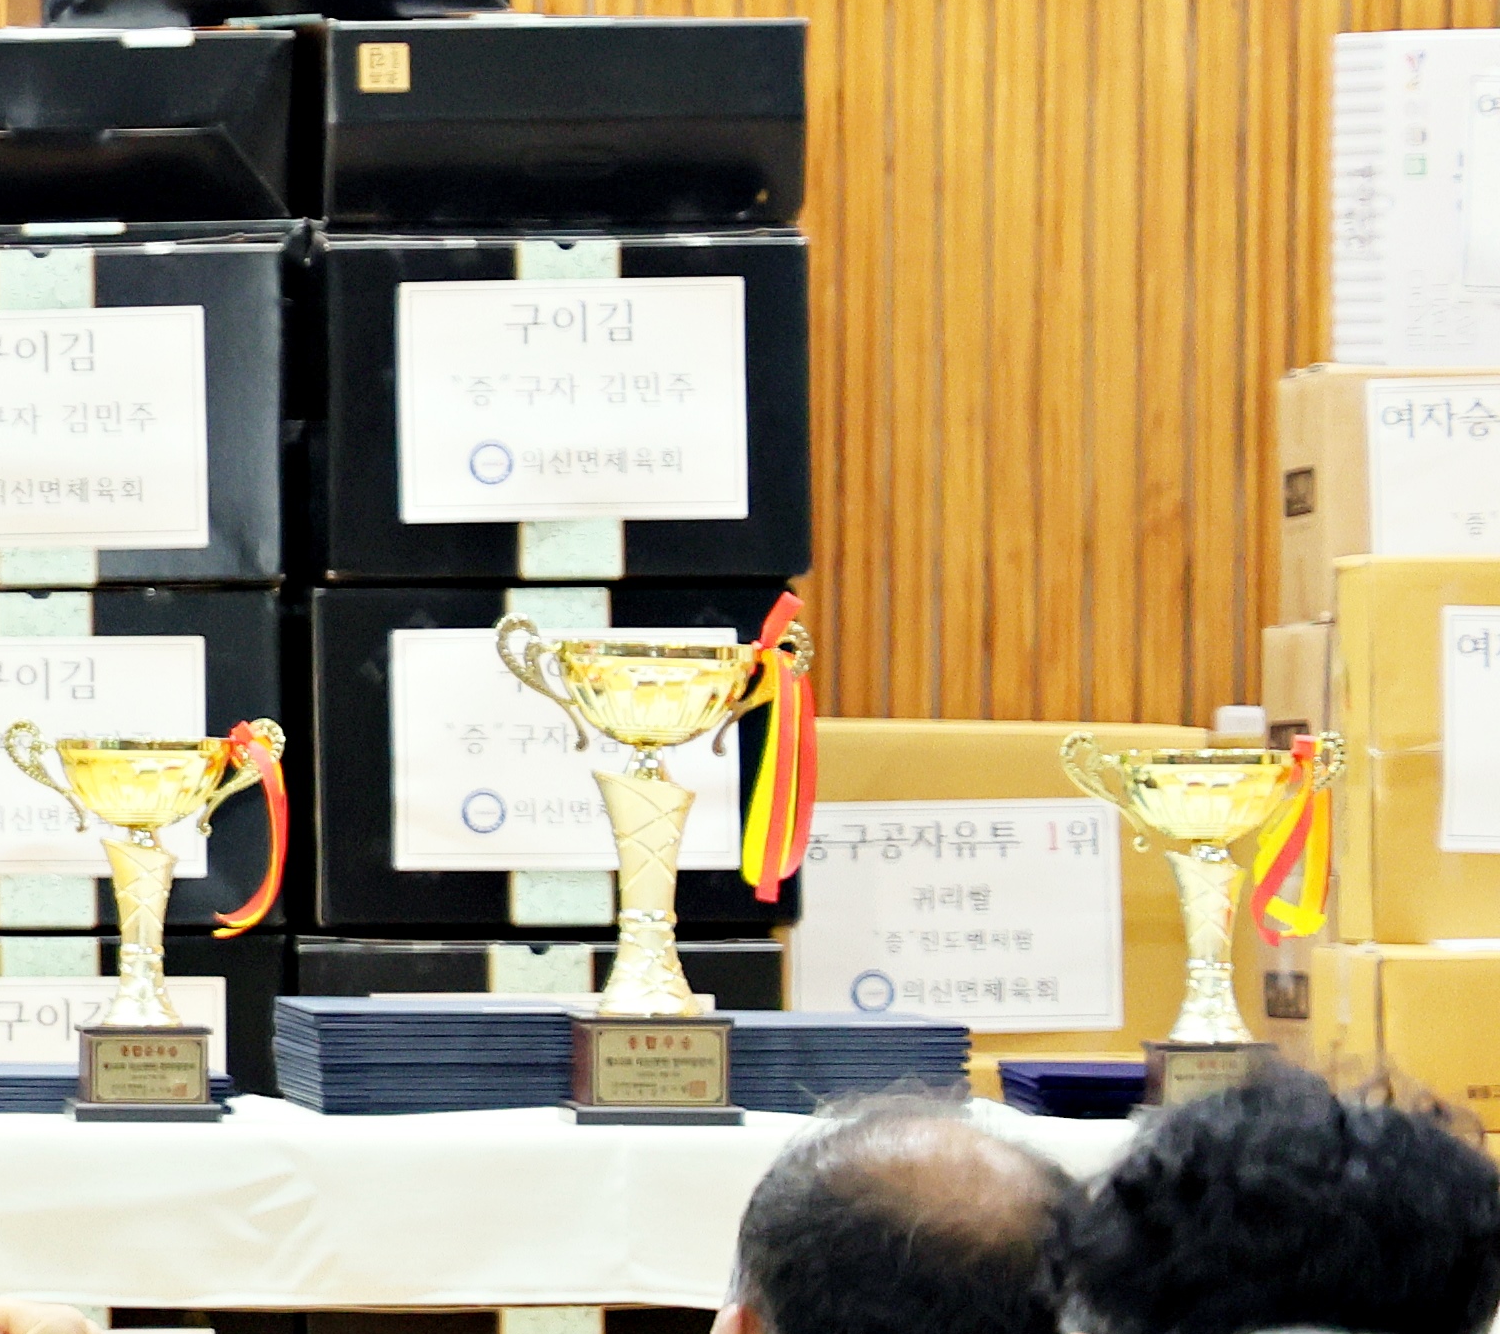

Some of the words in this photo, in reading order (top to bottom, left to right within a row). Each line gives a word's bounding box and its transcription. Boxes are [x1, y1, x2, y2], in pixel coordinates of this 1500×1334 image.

[503, 298, 633, 345] 구이김
[600, 371, 698, 404] 김민주
[63, 401, 158, 434] 김민주
[521, 446, 684, 475] 의신면체육회
